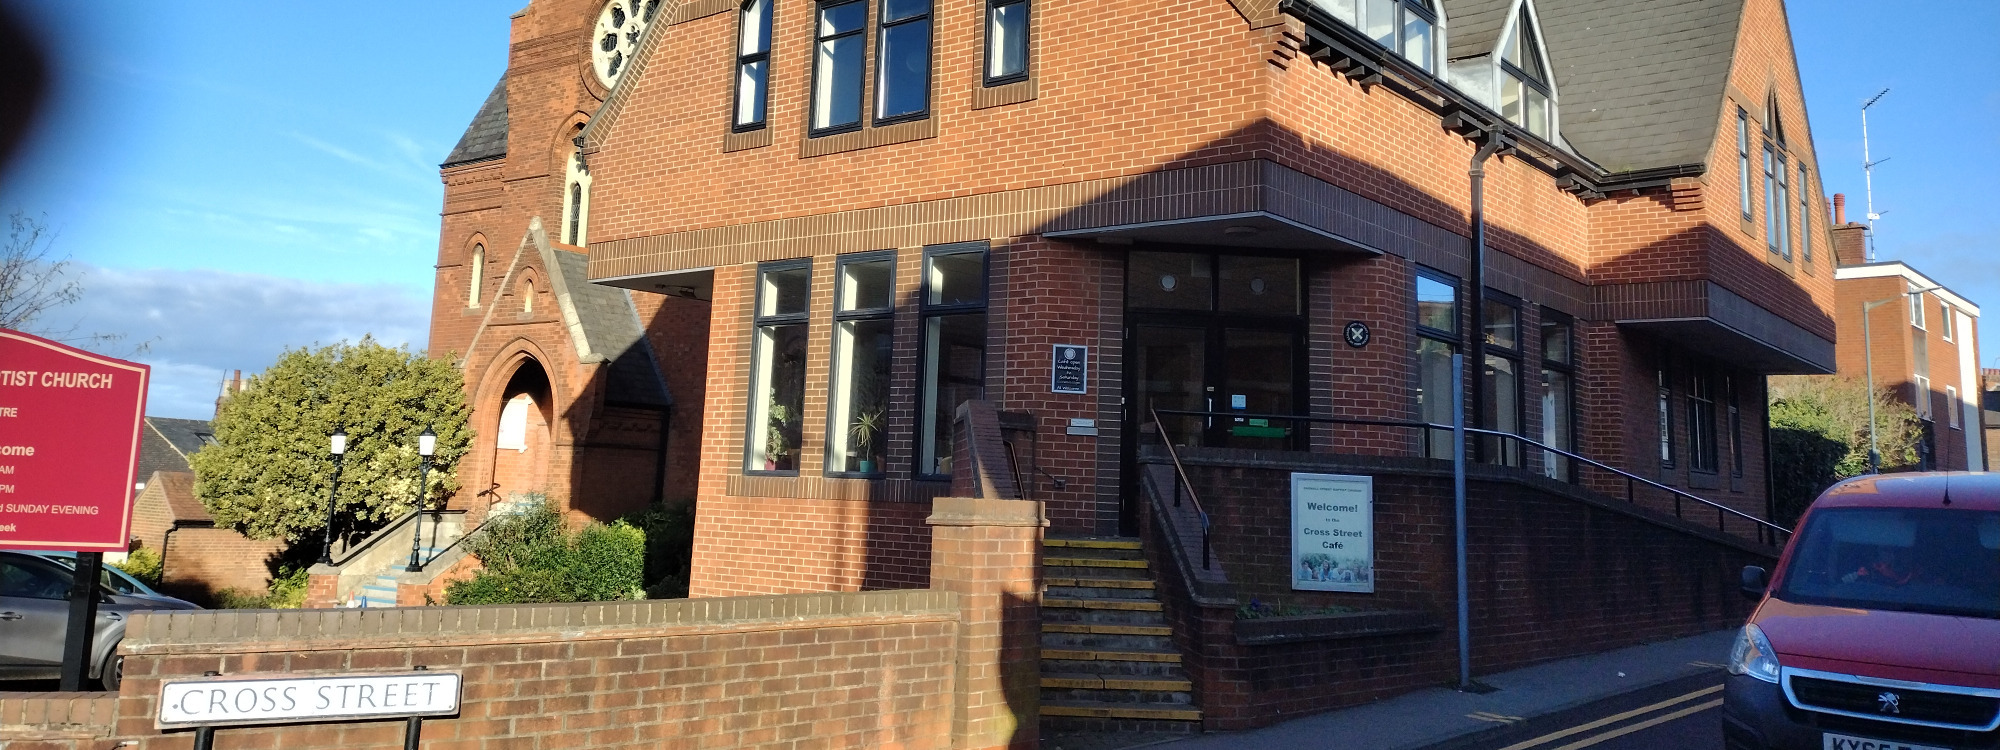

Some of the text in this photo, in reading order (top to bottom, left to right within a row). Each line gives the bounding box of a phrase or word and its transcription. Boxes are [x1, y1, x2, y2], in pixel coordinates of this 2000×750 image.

[0, 370, 113, 389] TIST CHURCH
[0, 445, 35, 457] ome
[6, 503, 50, 514] SUNDAY
[51, 505, 99, 515] EVENING
[1307, 502, 1358, 513] Welcome!
[1303, 527, 1363, 538] Cross Street
[1322, 541, 1344, 550] Café
[180, 682, 441, 715] CROSS STREET
